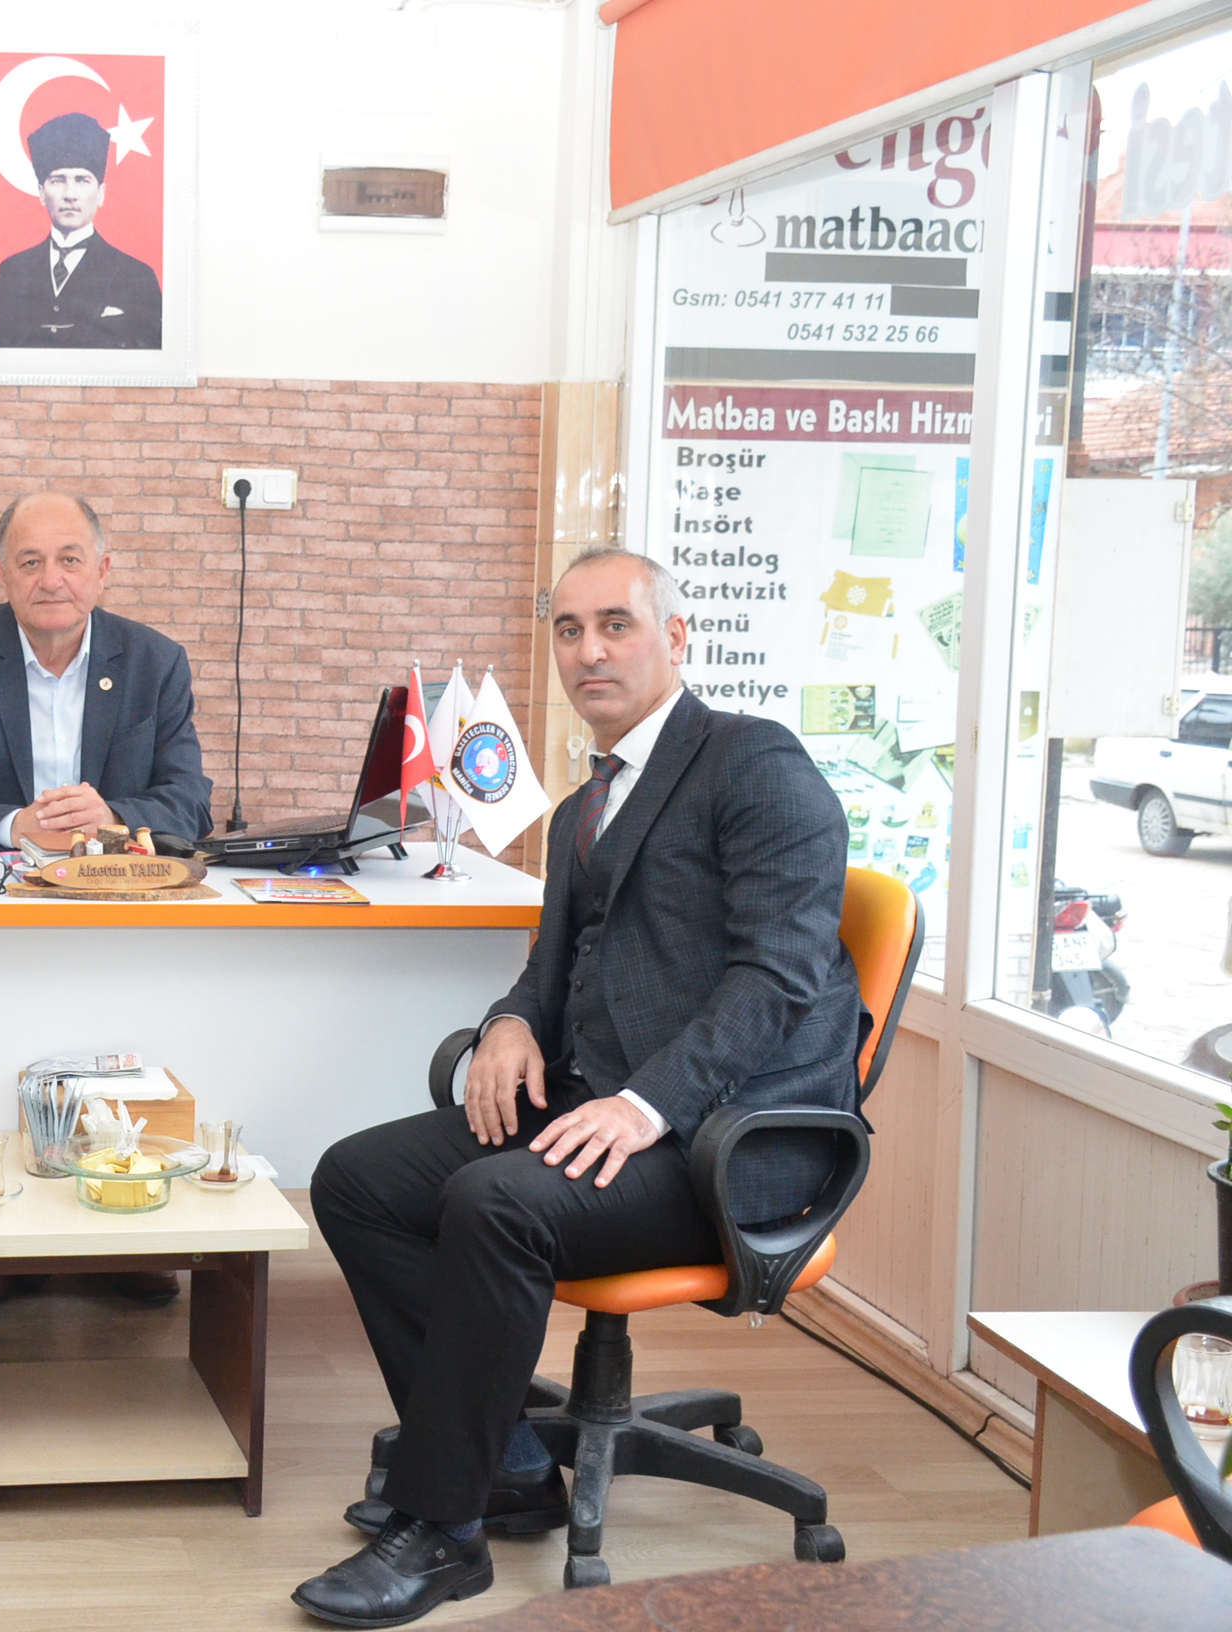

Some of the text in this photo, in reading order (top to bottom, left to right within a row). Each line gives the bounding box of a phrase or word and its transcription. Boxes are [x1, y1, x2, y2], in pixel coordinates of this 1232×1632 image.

[672, 288, 885, 310] Gsm: 0541 377 41 11
[787, 323, 939, 343] 0541 532 25 66
[666, 395, 775, 431] Matbaa
[785, 409, 817, 432] ve
[827, 398, 899, 434] Baskı
[676, 446, 766, 474] Broşür
[674, 507, 753, 534] İnsört
[672, 545, 779, 574] Katalog
[705, 639, 766, 665] İlanı
[681, 679, 789, 706] avetiye
[454, 724, 496, 757] GAZETECİLER
[496, 727, 505, 740] VE
[503, 737, 516, 785] YAYINCILAR
[452, 767, 474, 795] MANİSA
[77, 863, 173, 877] Alaettin YAKIN
